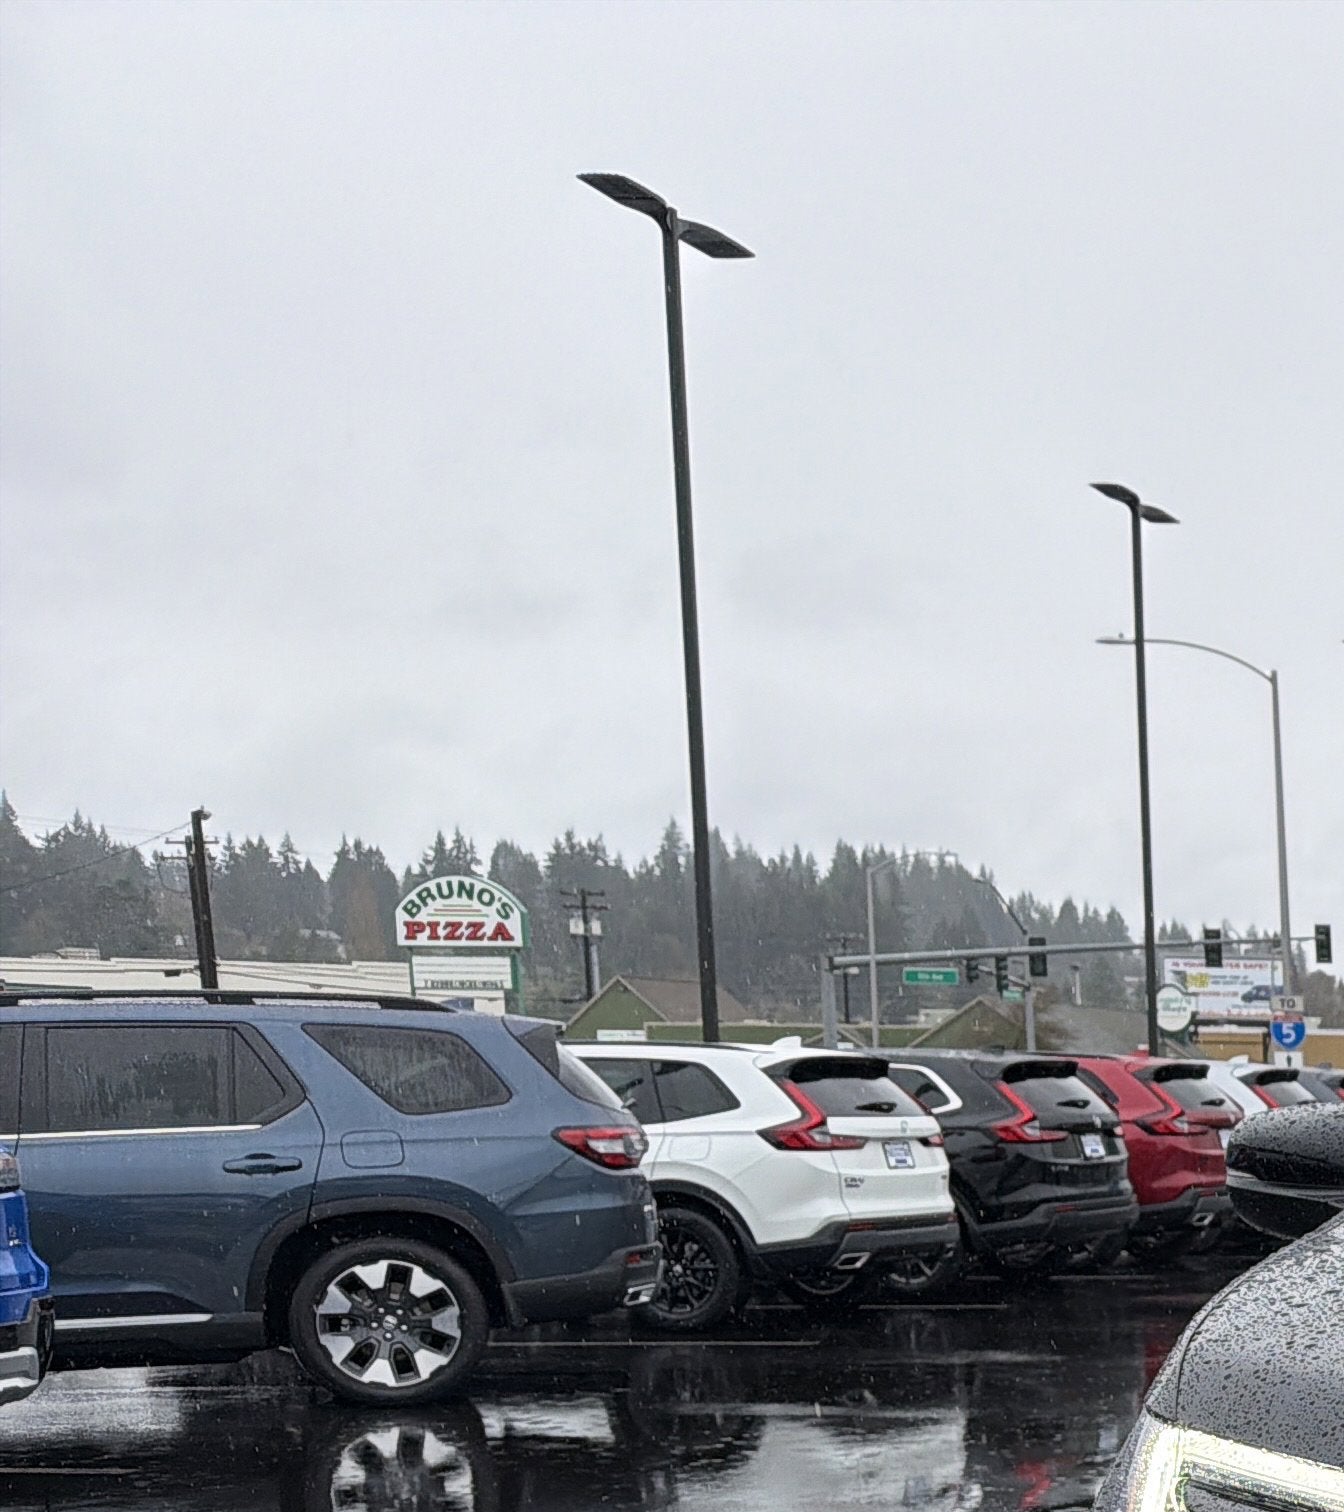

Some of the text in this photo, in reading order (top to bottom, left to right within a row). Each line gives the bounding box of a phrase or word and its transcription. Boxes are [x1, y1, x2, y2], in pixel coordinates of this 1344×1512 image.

[402, 880, 514, 920] BRUNO'S
[403, 921, 515, 941] PIZZA
[1279, 998, 1296, 1009] TO
[1282, 1023, 1296, 1044] 5
